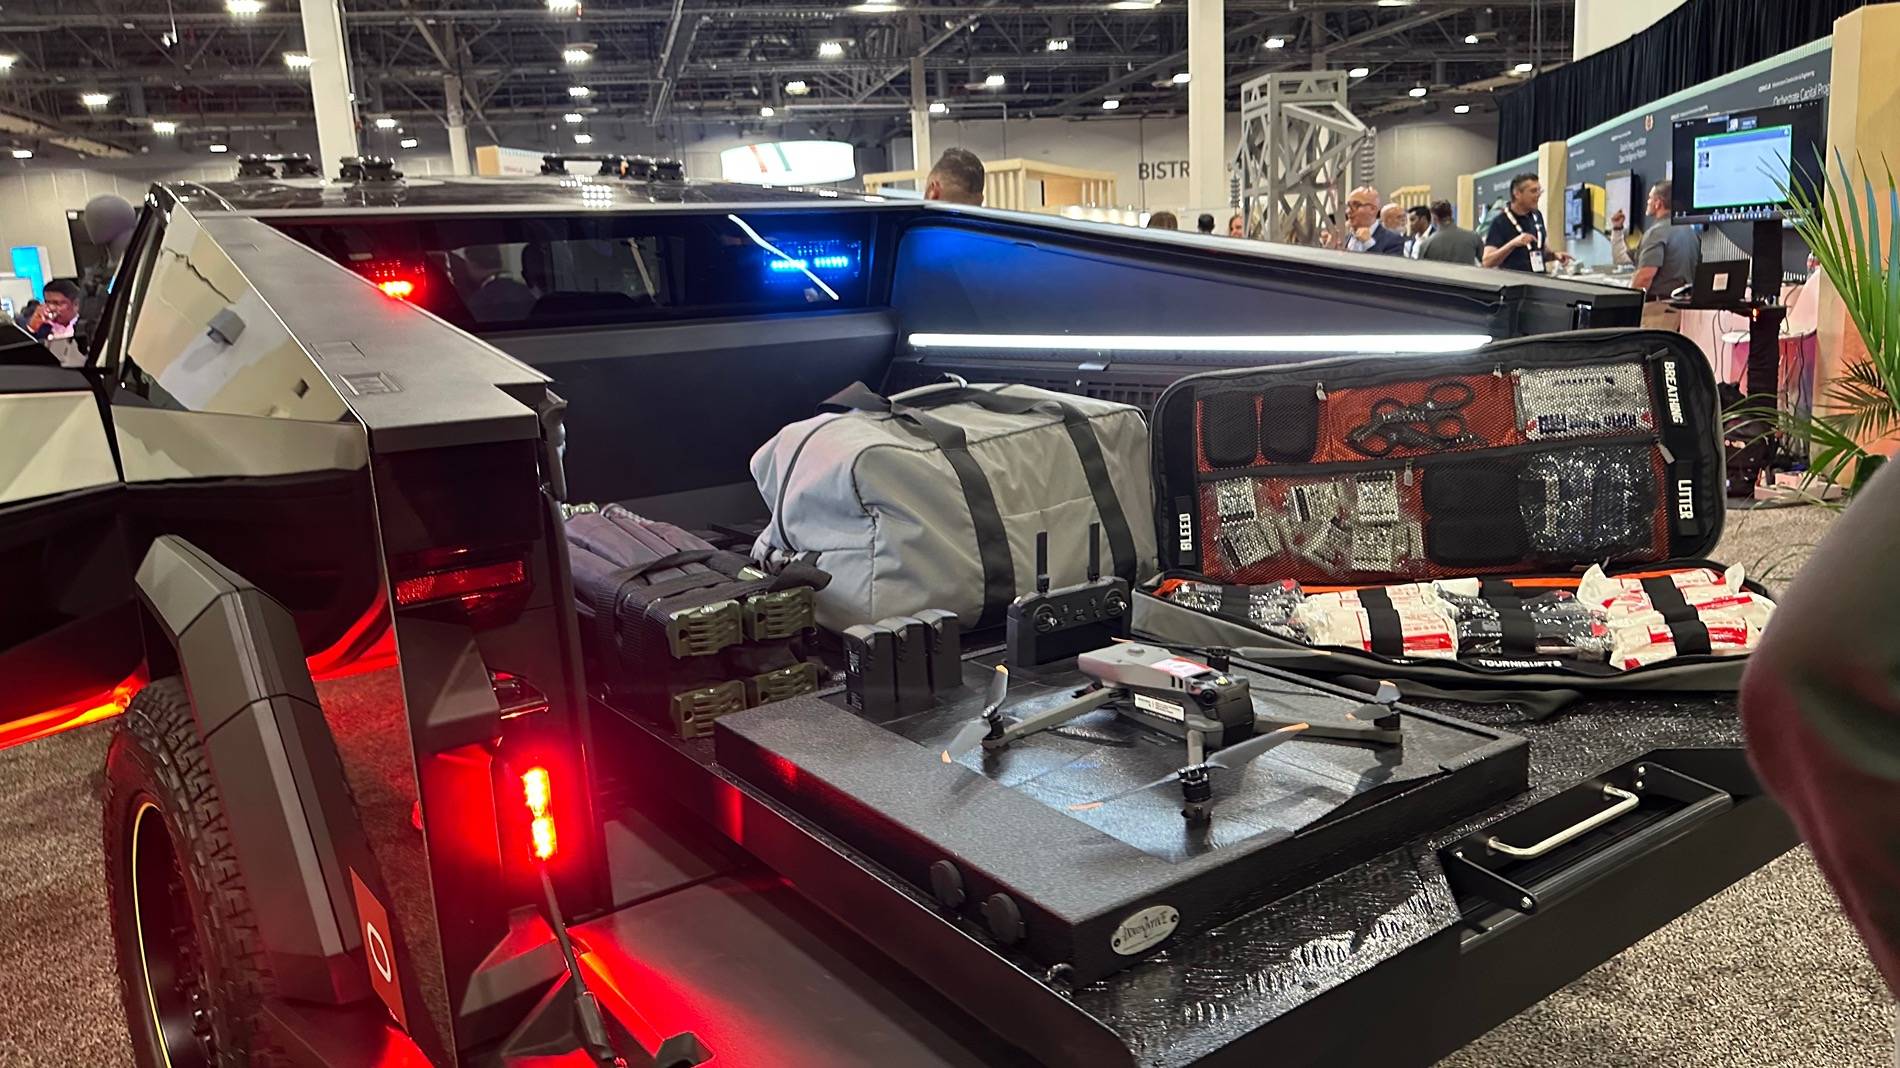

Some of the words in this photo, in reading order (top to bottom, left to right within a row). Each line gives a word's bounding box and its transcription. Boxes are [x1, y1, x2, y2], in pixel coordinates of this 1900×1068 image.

[1139, 160, 1189, 180] BISTR
[1663, 361, 1683, 425] BREATHING
[1677, 479, 1694, 520] LITTER
[1179, 513, 1192, 551] BLEED
